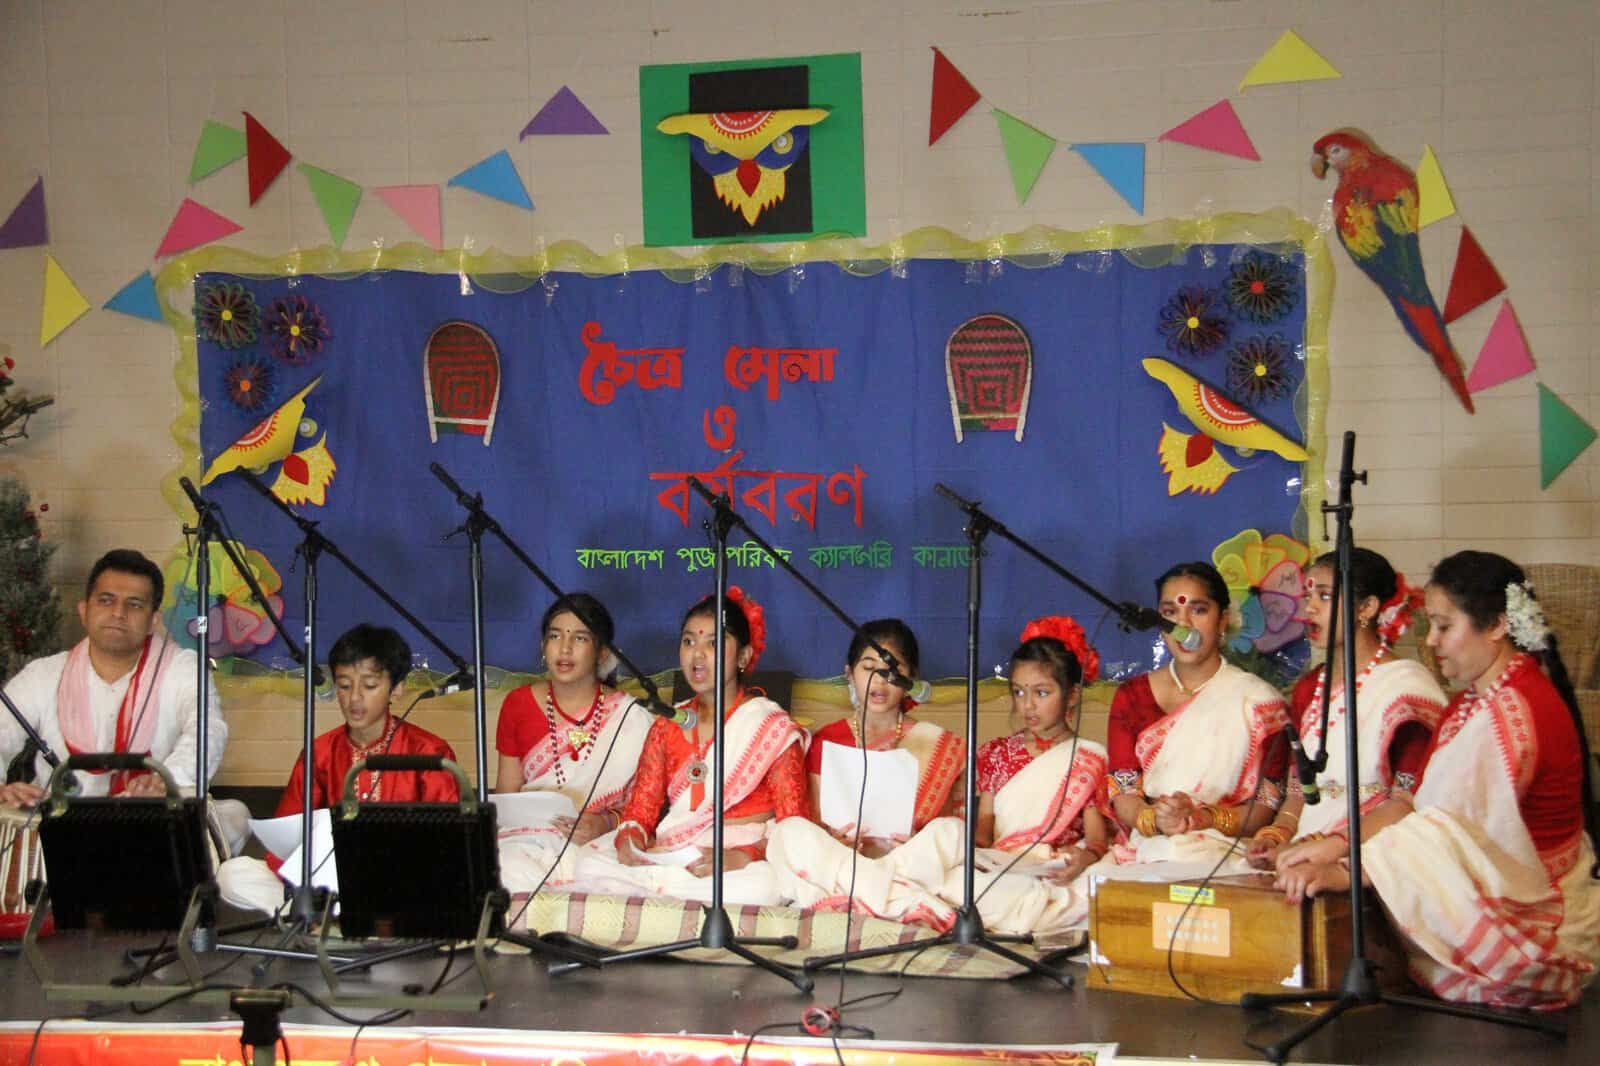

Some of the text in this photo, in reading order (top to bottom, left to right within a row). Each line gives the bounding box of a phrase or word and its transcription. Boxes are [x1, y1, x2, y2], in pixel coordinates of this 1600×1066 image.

[579, 321, 840, 405] চৈত্র মেলা
[703, 404, 737, 451] ও
[576, 548, 665, 571] বাংলাদেশ
